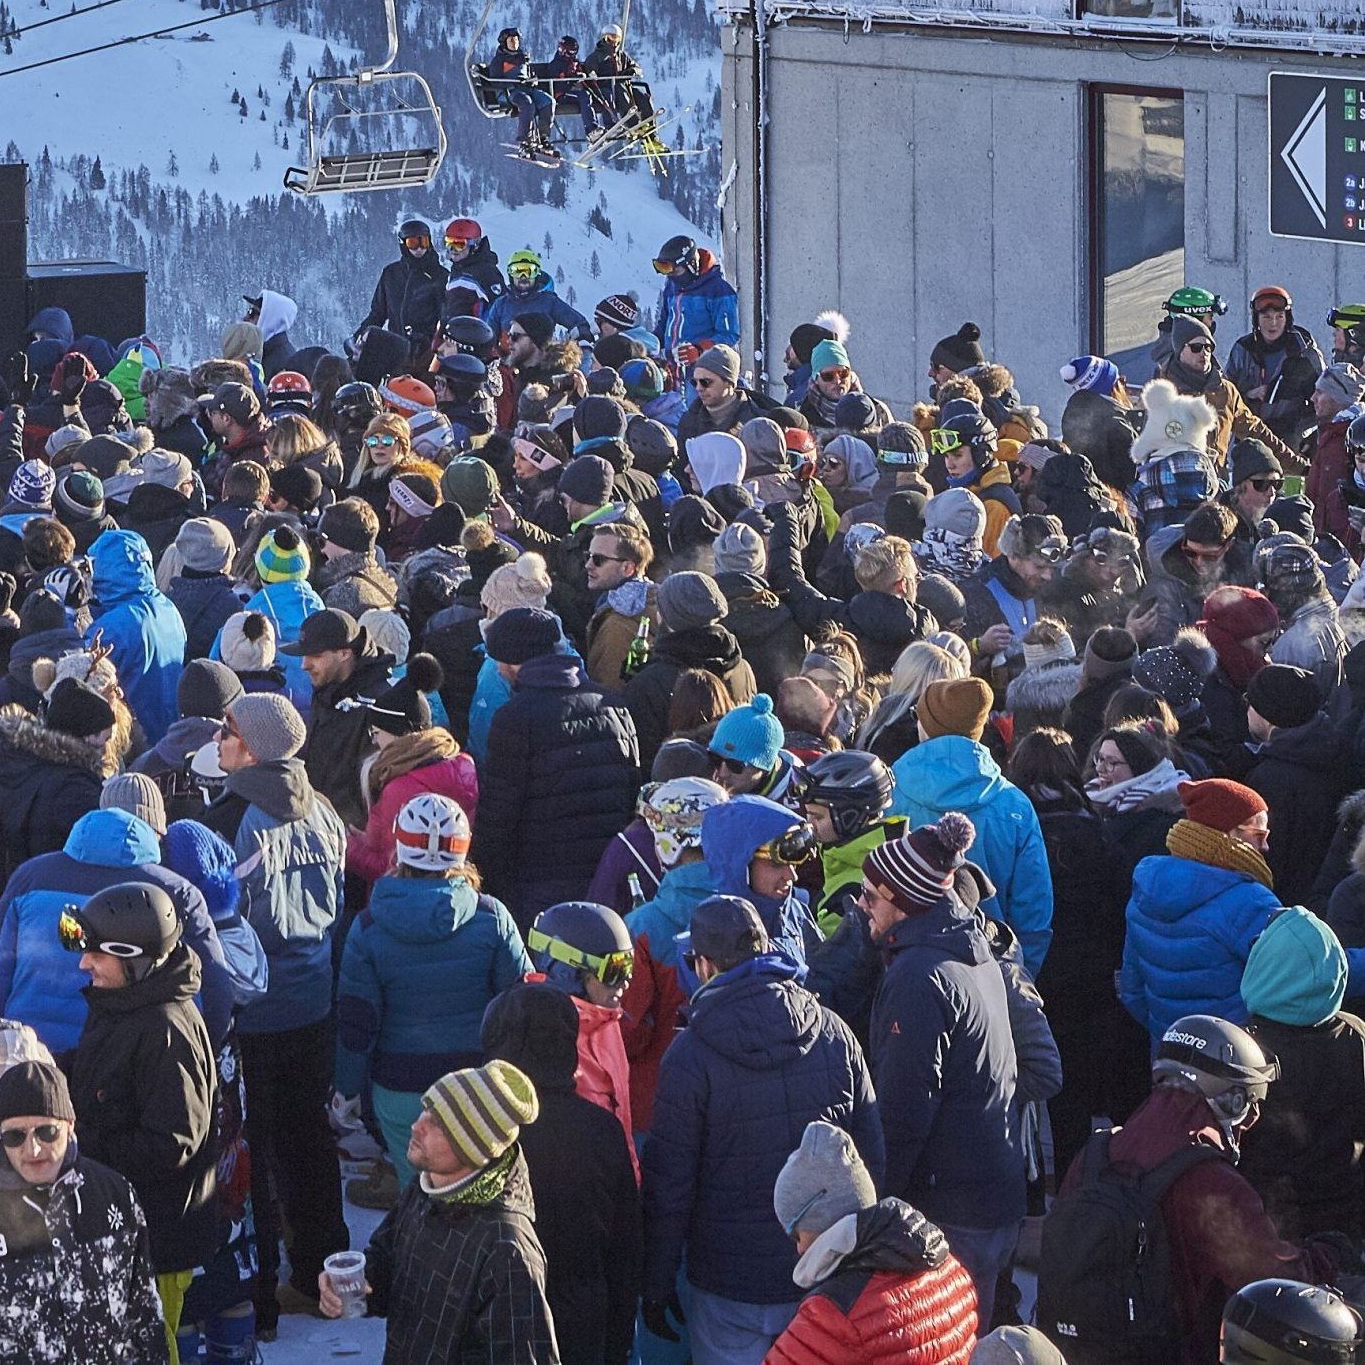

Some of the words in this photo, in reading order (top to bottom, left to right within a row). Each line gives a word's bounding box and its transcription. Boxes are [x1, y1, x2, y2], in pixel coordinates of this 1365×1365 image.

[1345, 177, 1356, 187] 2a
[1345, 198, 1356, 208] 2b
[1347, 218, 1354, 228] 3
[1184, 305, 1213, 314] uvex
